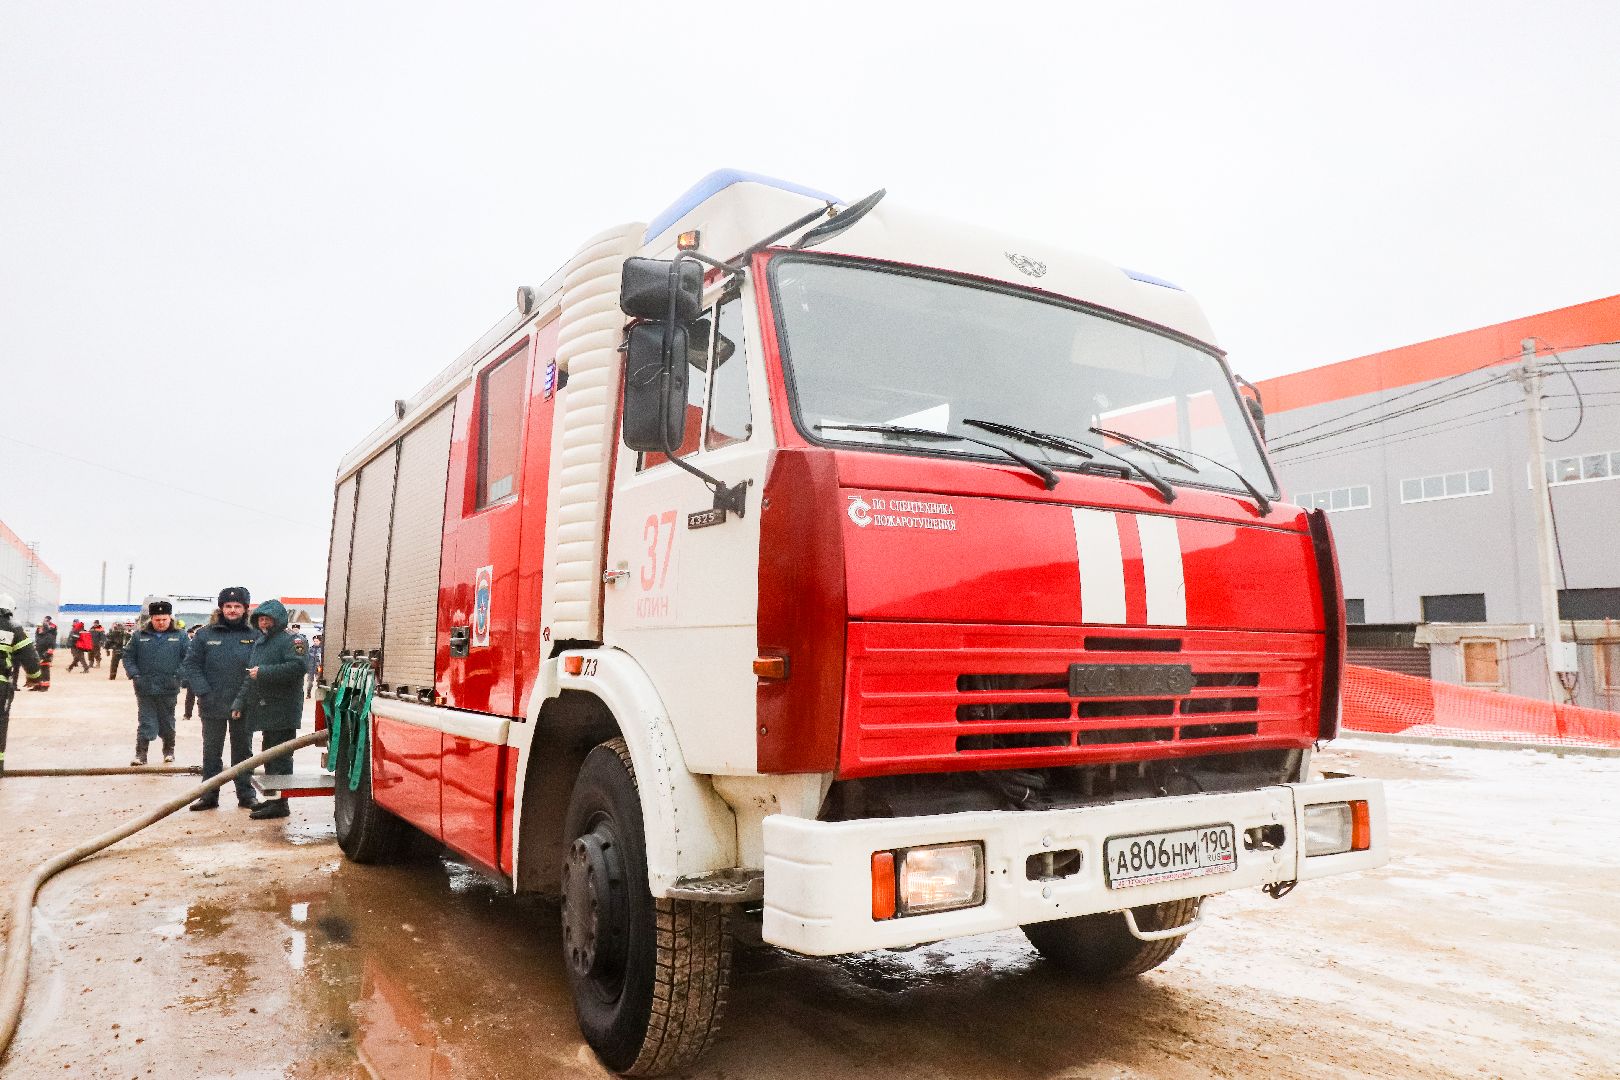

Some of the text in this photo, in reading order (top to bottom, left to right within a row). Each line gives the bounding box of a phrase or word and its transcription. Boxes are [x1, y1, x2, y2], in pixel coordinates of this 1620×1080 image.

[872, 498, 955, 515] ПО СПЕЦТЕХНИКА
[873, 514, 957, 531] ПОЖАРОТУШЕНИЯ
[640, 510, 678, 592] 37
[635, 597, 669, 618] КЛИН
[1200, 829, 1230, 853] 190
[1208, 853, 1221, 862] RUS
